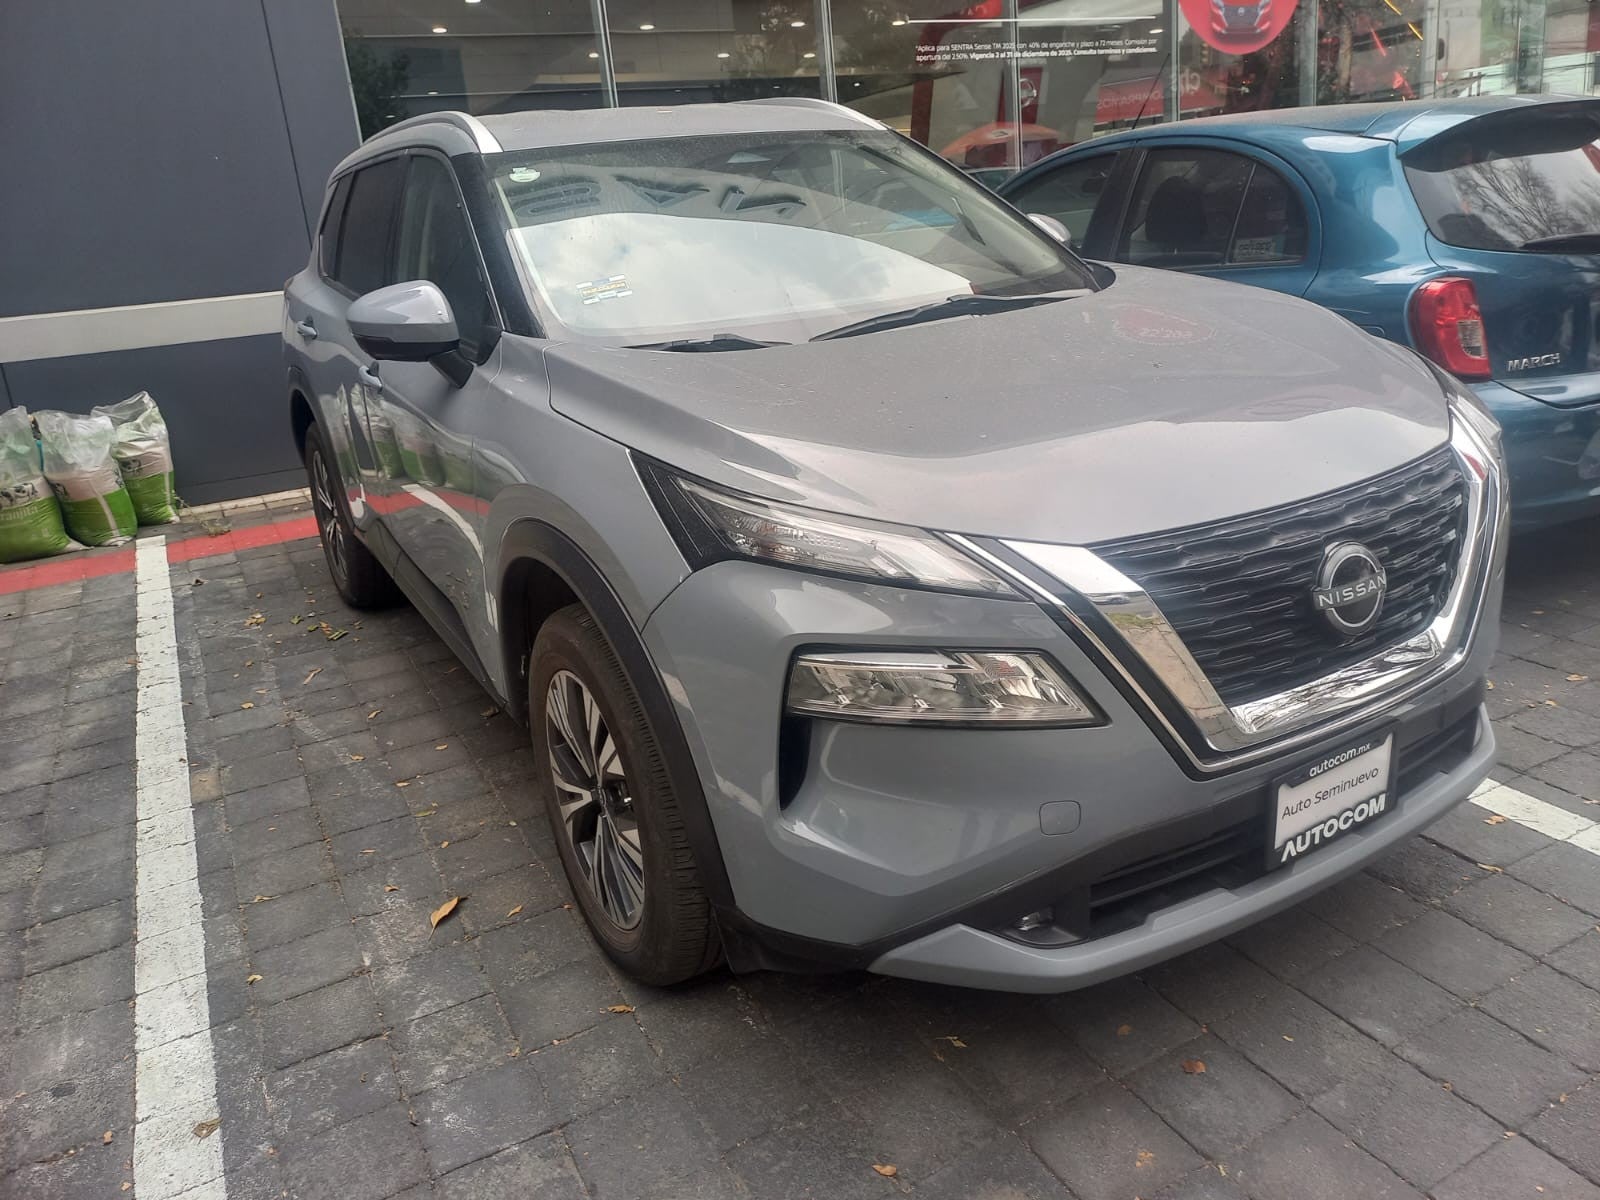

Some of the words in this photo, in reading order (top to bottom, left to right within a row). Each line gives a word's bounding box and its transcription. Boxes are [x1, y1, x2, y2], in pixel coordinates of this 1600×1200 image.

[970, 52, 994, 61] Vigencia
[1507, 352, 1561, 371] MARCH
[1318, 575, 1386, 607] NISSAN
[1309, 743, 1371, 777] autocom.mx
[1282, 797, 1312, 820] Auto
[1314, 767, 1379, 804] Seminuevo
[1281, 793, 1386, 863] AUTOCOM
